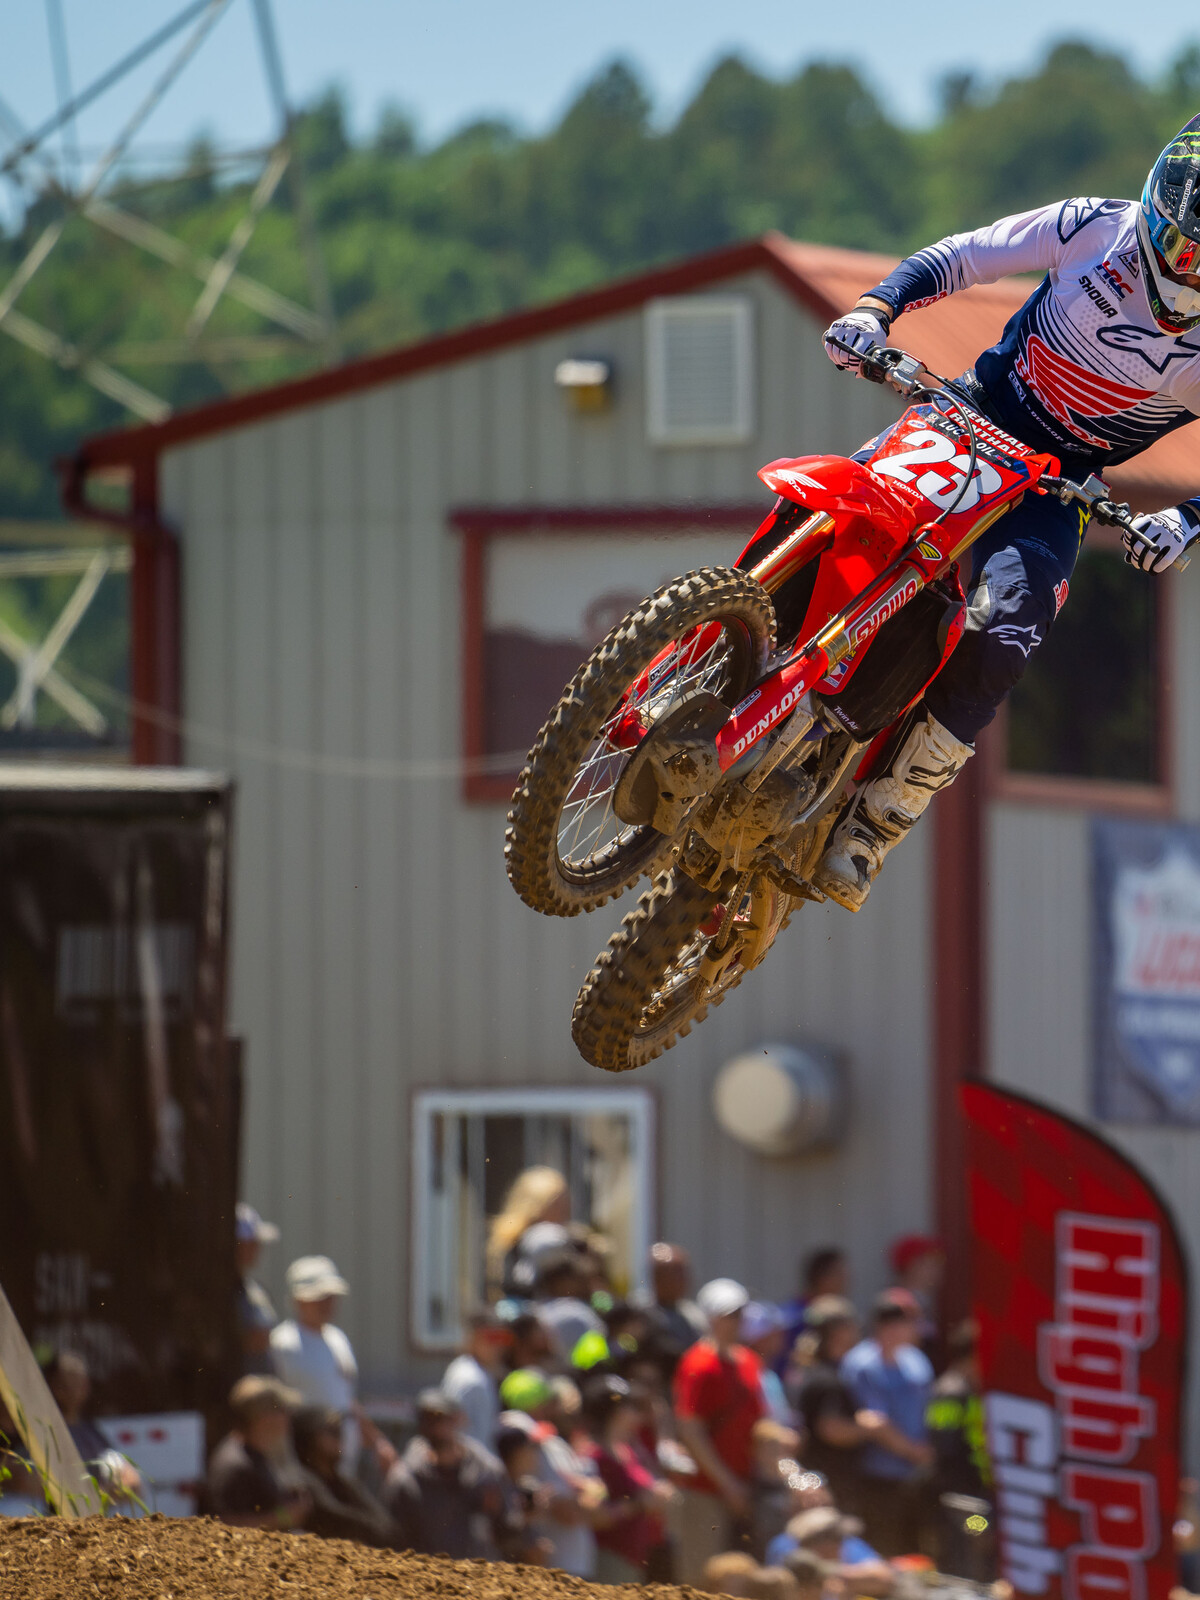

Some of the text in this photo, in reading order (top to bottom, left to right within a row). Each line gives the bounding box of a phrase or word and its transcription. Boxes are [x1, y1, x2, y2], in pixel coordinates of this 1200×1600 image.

[1078, 275, 1118, 319] SHOWA
[1095, 260, 1134, 299] HRC
[1014, 353, 1114, 450] HONDA
[939, 420, 978, 442] LUC
[976, 442, 996, 456] OIL
[1030, 411, 1064, 441] DUNLOP
[872, 429, 1003, 514] 23
[891, 479, 925, 501] HONDA
[732, 680, 805, 757] DUNLOP
[833, 705, 859, 731] Twin Air
[1037, 1210, 1160, 1464] High
[985, 1390, 1063, 1596] Club
